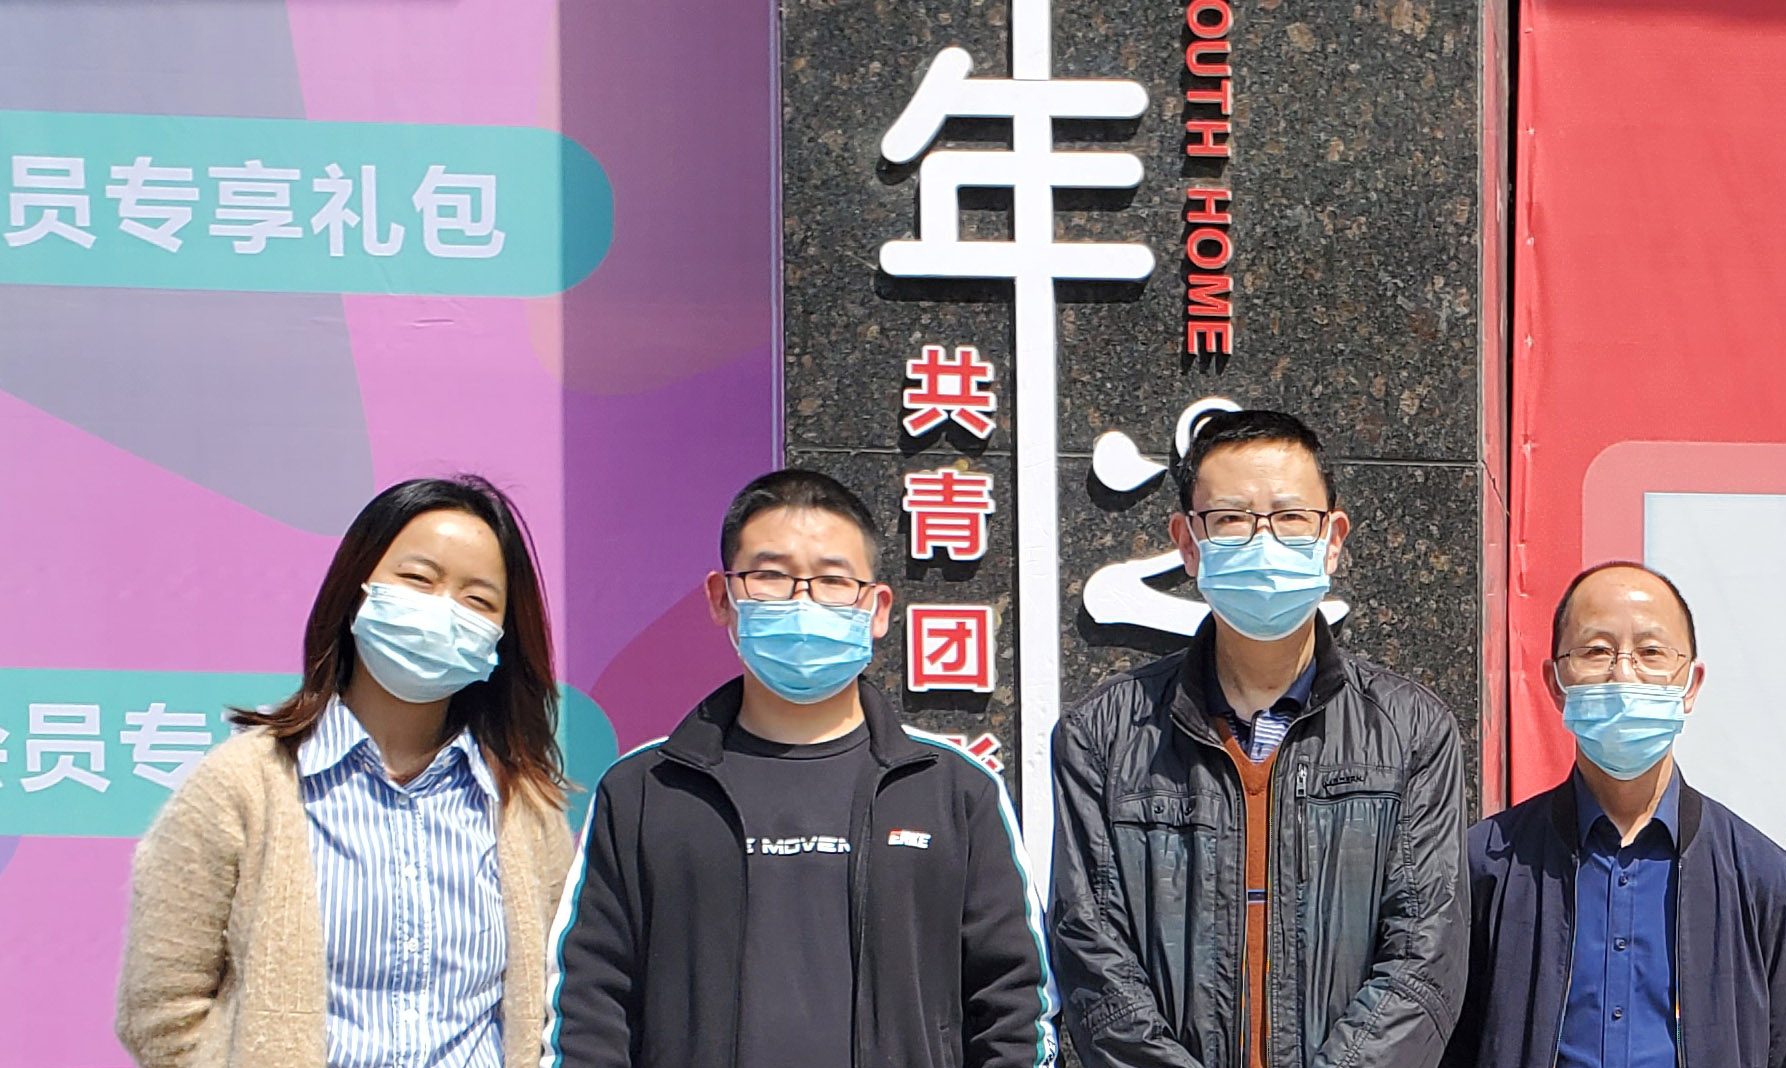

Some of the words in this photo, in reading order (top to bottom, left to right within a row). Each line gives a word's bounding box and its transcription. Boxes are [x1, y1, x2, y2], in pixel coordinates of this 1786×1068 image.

[4, 154, 507, 259] 员专享礼包
[1186, 188, 1233, 355] HOME
[902, 346, 1004, 775] 共青团
